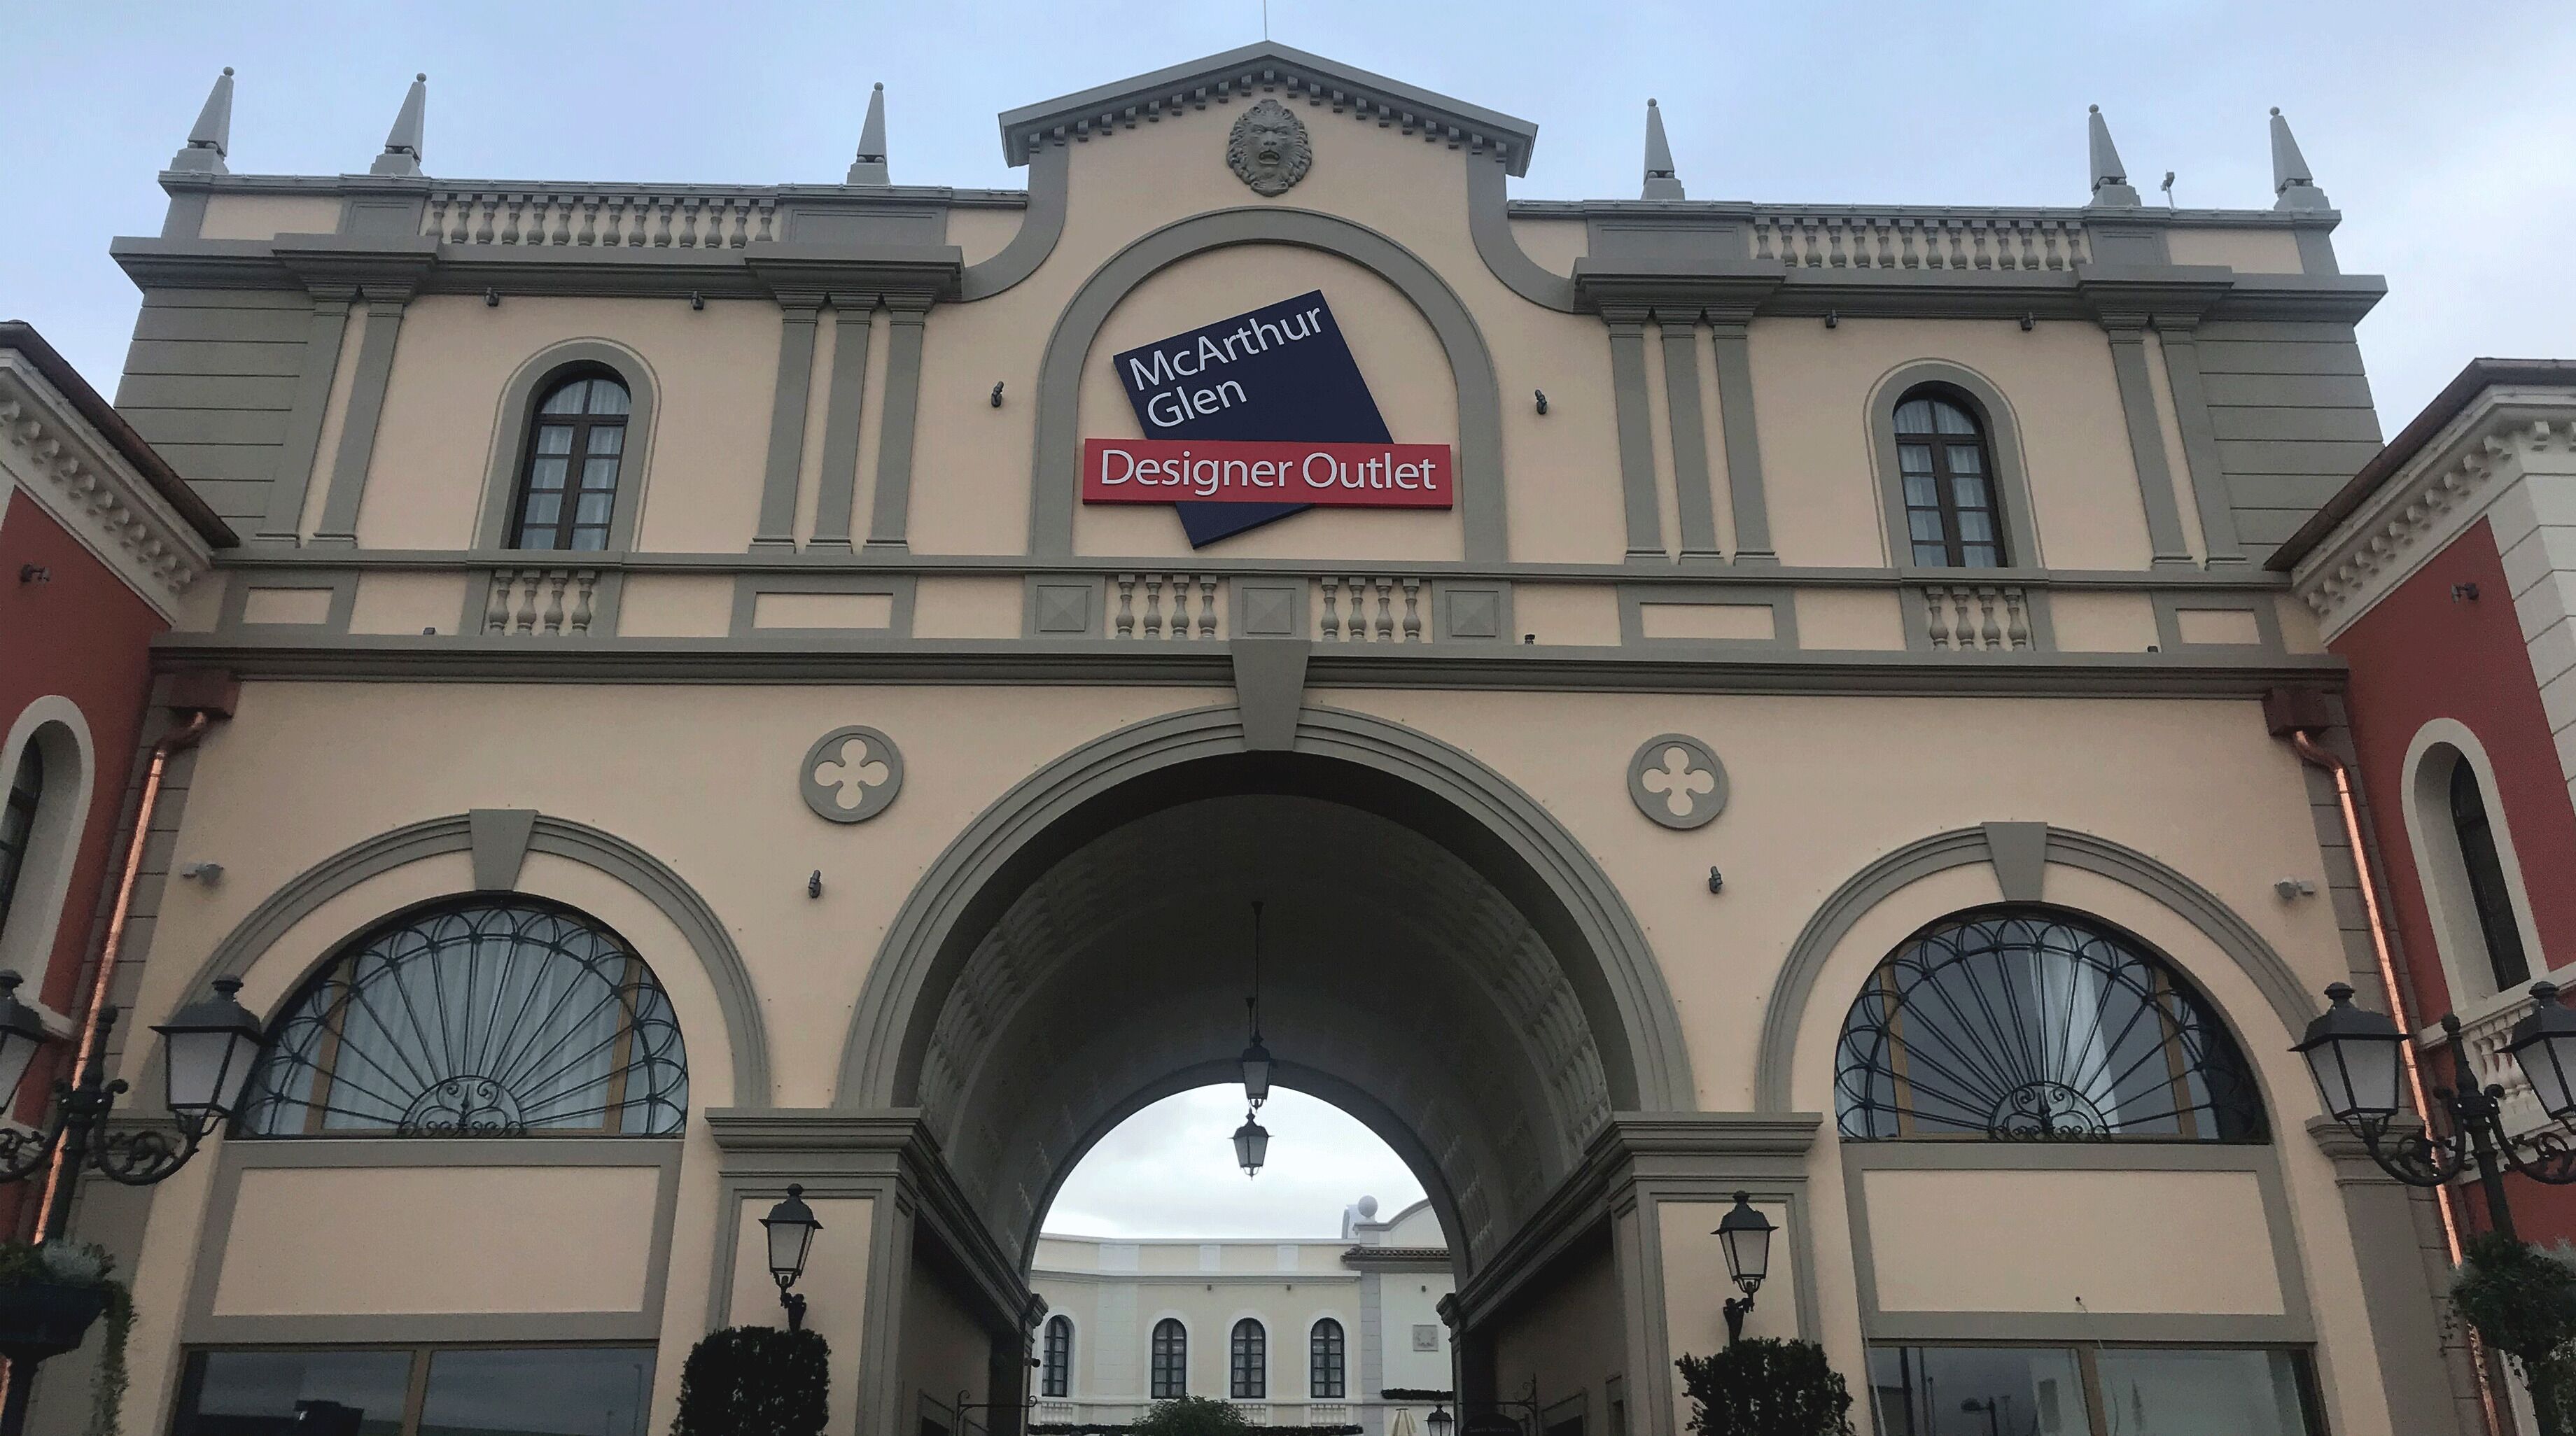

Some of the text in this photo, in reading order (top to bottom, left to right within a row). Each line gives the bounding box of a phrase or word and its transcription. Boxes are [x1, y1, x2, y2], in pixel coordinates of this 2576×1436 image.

[1129, 307, 1322, 391] McArthur
[1147, 379, 1247, 428] Glen
[1101, 449, 1437, 496] Designer Outlet
